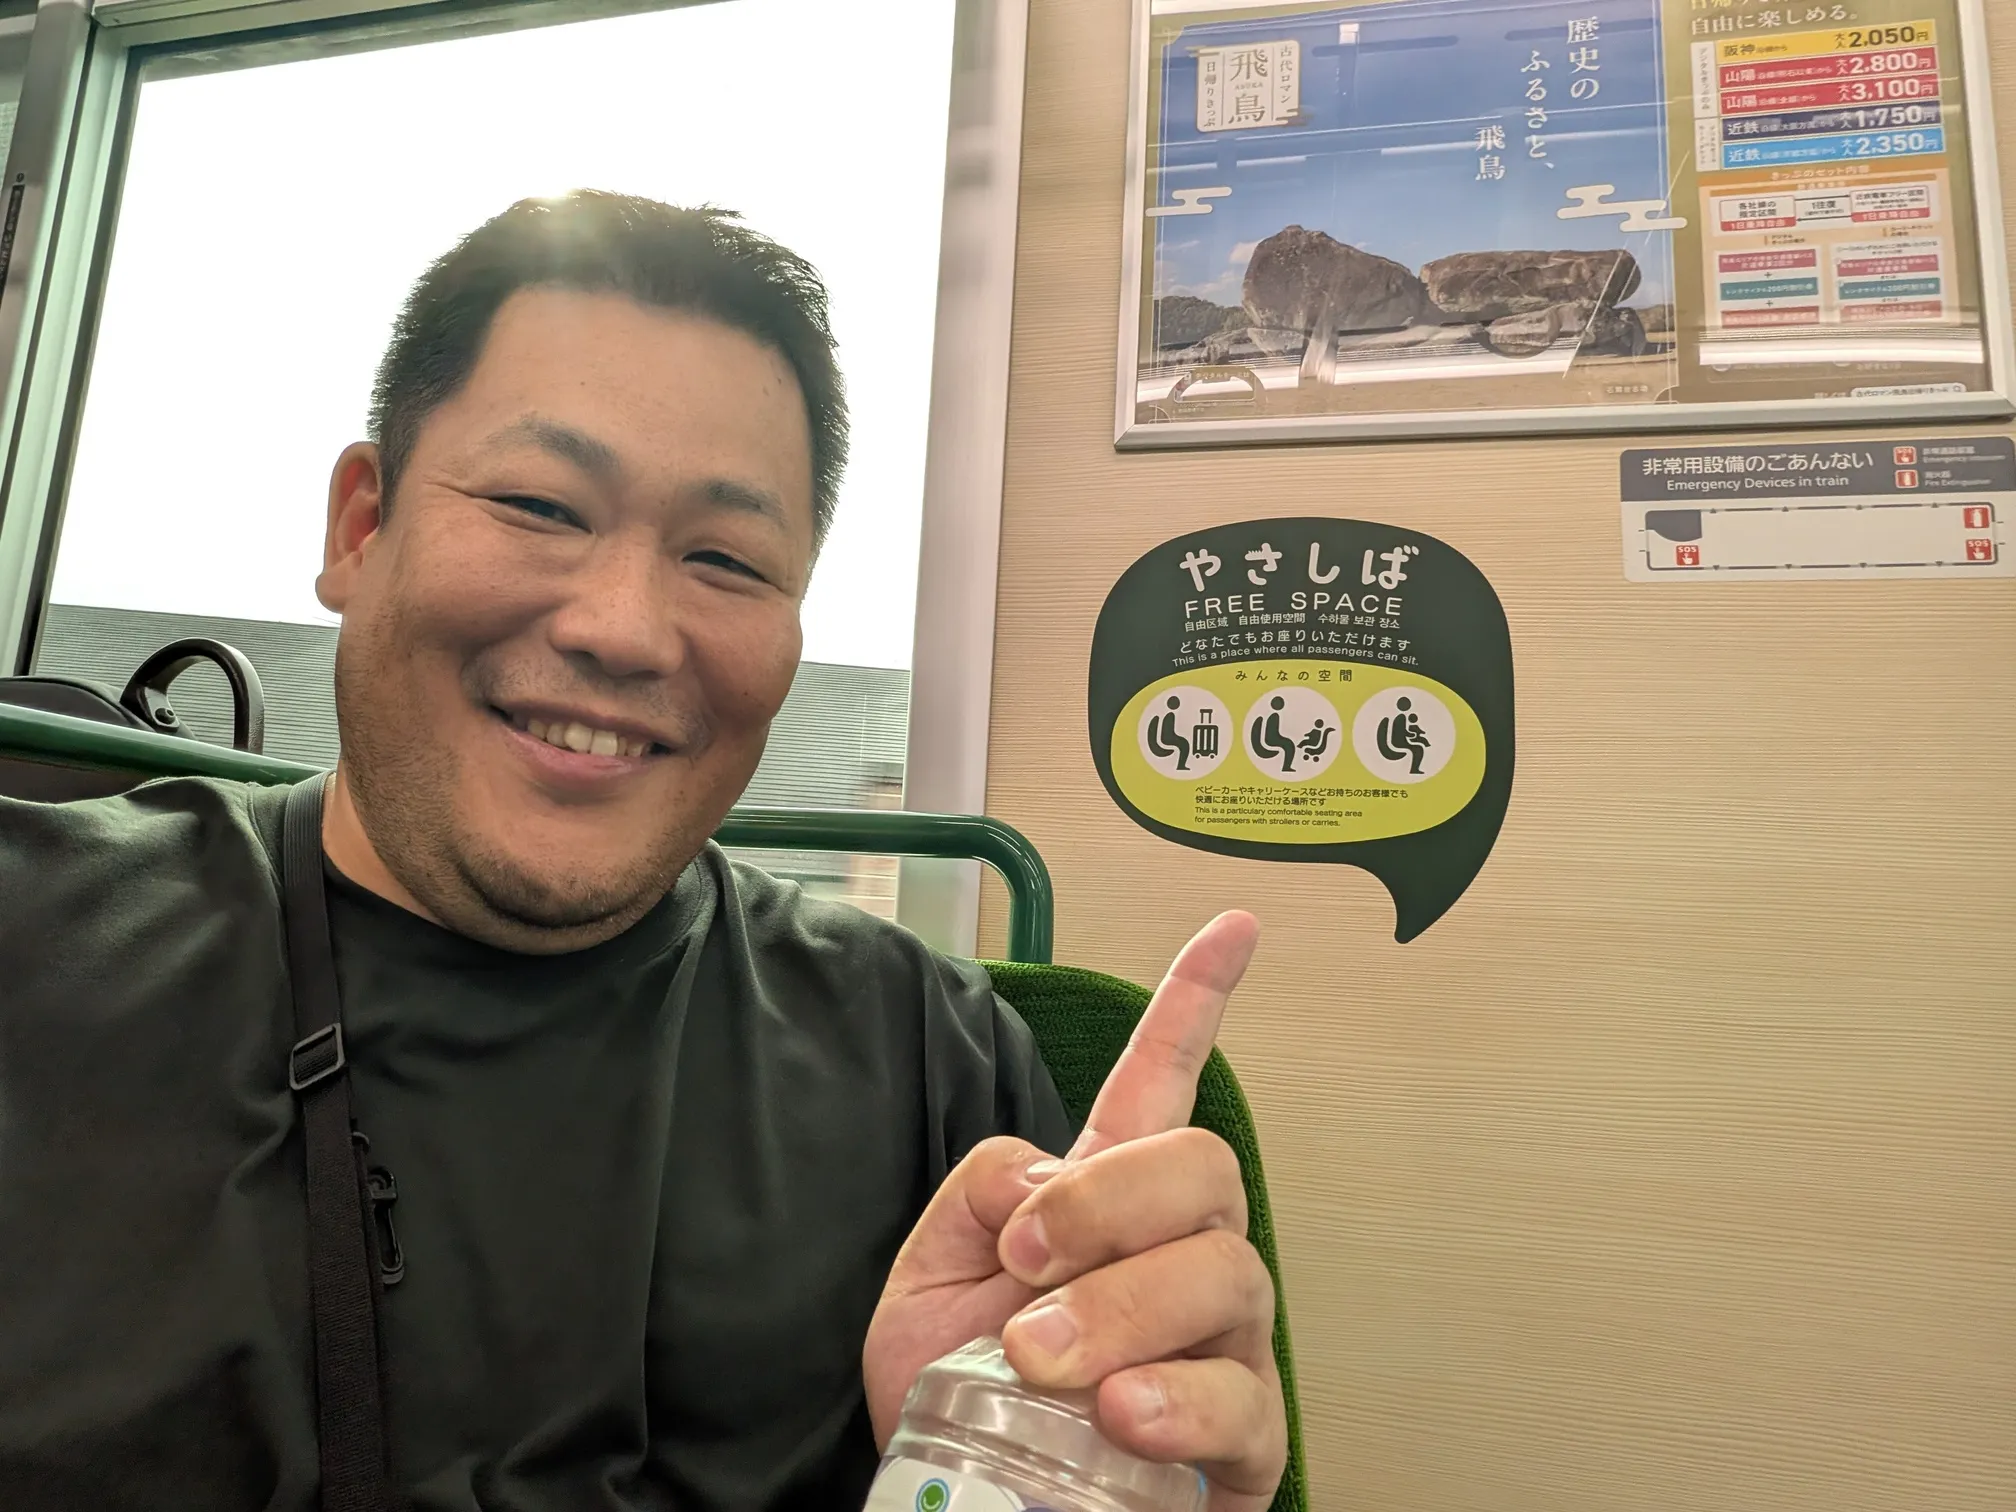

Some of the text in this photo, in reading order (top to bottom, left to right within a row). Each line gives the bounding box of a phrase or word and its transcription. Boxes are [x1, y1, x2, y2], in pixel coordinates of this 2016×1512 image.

[1691, 4, 1858, 35] 自由に楽しめる。
[1566, 16, 1601, 100] 歴史の
[1280, 46, 1293, 104] 古代ロマン
[1228, 48, 1269, 125] 飛鳥
[1520, 50, 1555, 169] ふるさと、
[1475, 125, 1506, 181] 飛鳥
[1641, 451, 1875, 476] 非常用設備のごあんない
[1667, 475, 1849, 492] Emergency Devices in train
[1677, 545, 1698, 553] SOS
[1967, 540, 1989, 548] SOS
[1179, 542, 1420, 592] やさしば
[1184, 591, 1403, 619] FREE SPACE
[1184, 616, 1229, 632] 自由区域
[1239, 613, 1306, 625] 自由使用空間
[1318, 613, 1401, 630] 수하물 보관 장소
[1180, 629, 1412, 654] どなたでもお座りいただけます
[1172, 655, 1196, 668] This
[1197, 653, 1208, 662] is
[1220, 647, 1251, 659] place
[1254, 645, 1288, 654] where
[1291, 644, 1304, 653] all
[1307, 645, 1374, 658] passengers
[1377, 651, 1398, 662] can
[1401, 655, 1419, 666] sit.
[1235, 669, 1353, 682] みんなの空間
[1195, 785, 1409, 799] ベビーカーやキャリーケースなどお持ちのお客様でも
[1195, 795, 1327, 807] 快適にお座りいただける場所です
[1195, 806, 1210, 814] This
[1267, 807, 1313, 816] comfortable
[1314, 809, 1343, 818] seating
[1206, 817, 1251, 825] passengers
[1252, 817, 1268, 825] with
[1269, 817, 1300, 826] strollers
[1311, 819, 1341, 827] carries.
